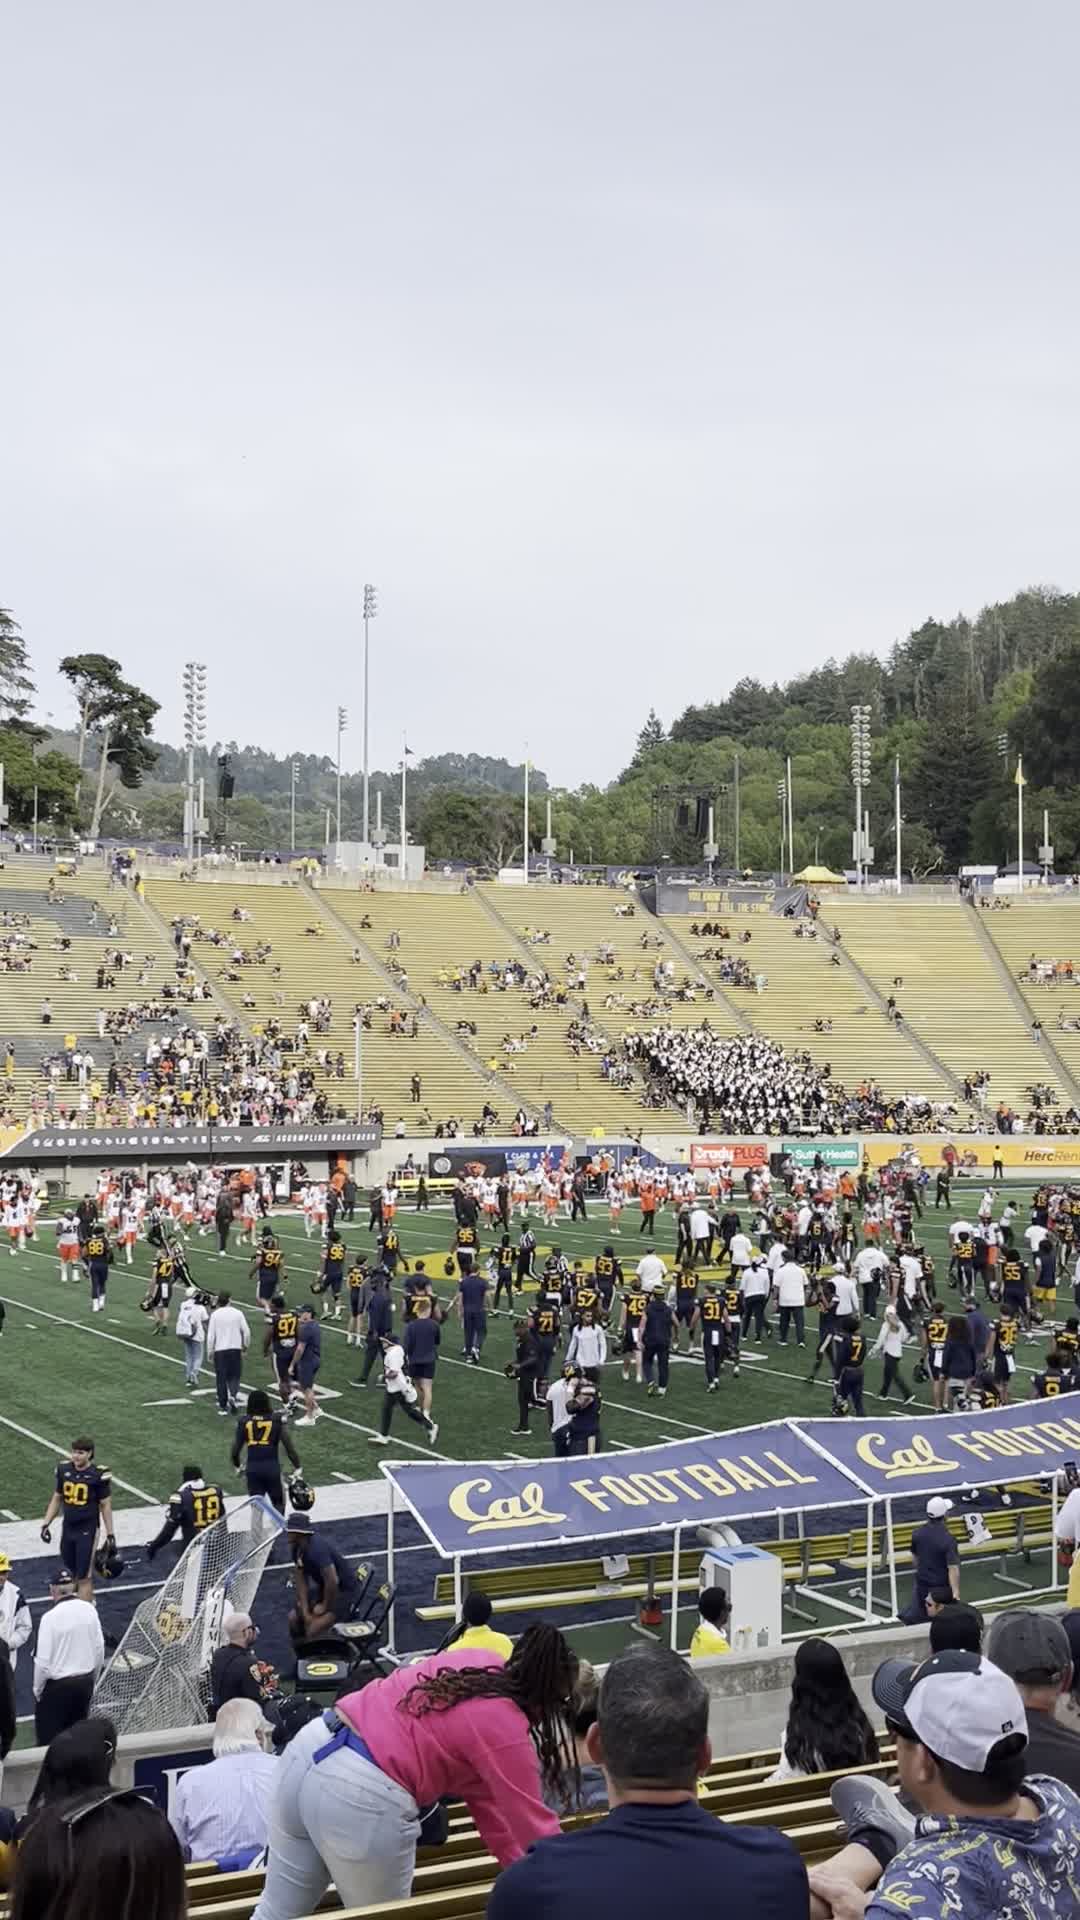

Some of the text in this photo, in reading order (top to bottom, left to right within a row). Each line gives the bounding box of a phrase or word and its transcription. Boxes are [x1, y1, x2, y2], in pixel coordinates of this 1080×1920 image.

[827, 1150, 858, 1160] Health
[1024, 1151, 1080, 1161] HercRen
[681, 1275, 696, 1288] 10
[1004, 1266, 1021, 1280] 55
[577, 1291, 596, 1307] 57
[703, 1302, 721, 1320] 31
[278, 1317, 297, 1337] 97
[928, 1323, 948, 1342] 27
[851, 1341, 862, 1361] 7
[245, 1421, 272, 1446] 17
[856, 1432, 960, 1480] Cal
[63, 1481, 88, 1506] 90
[449, 1450, 819, 1535] Cal FOOTBALL
